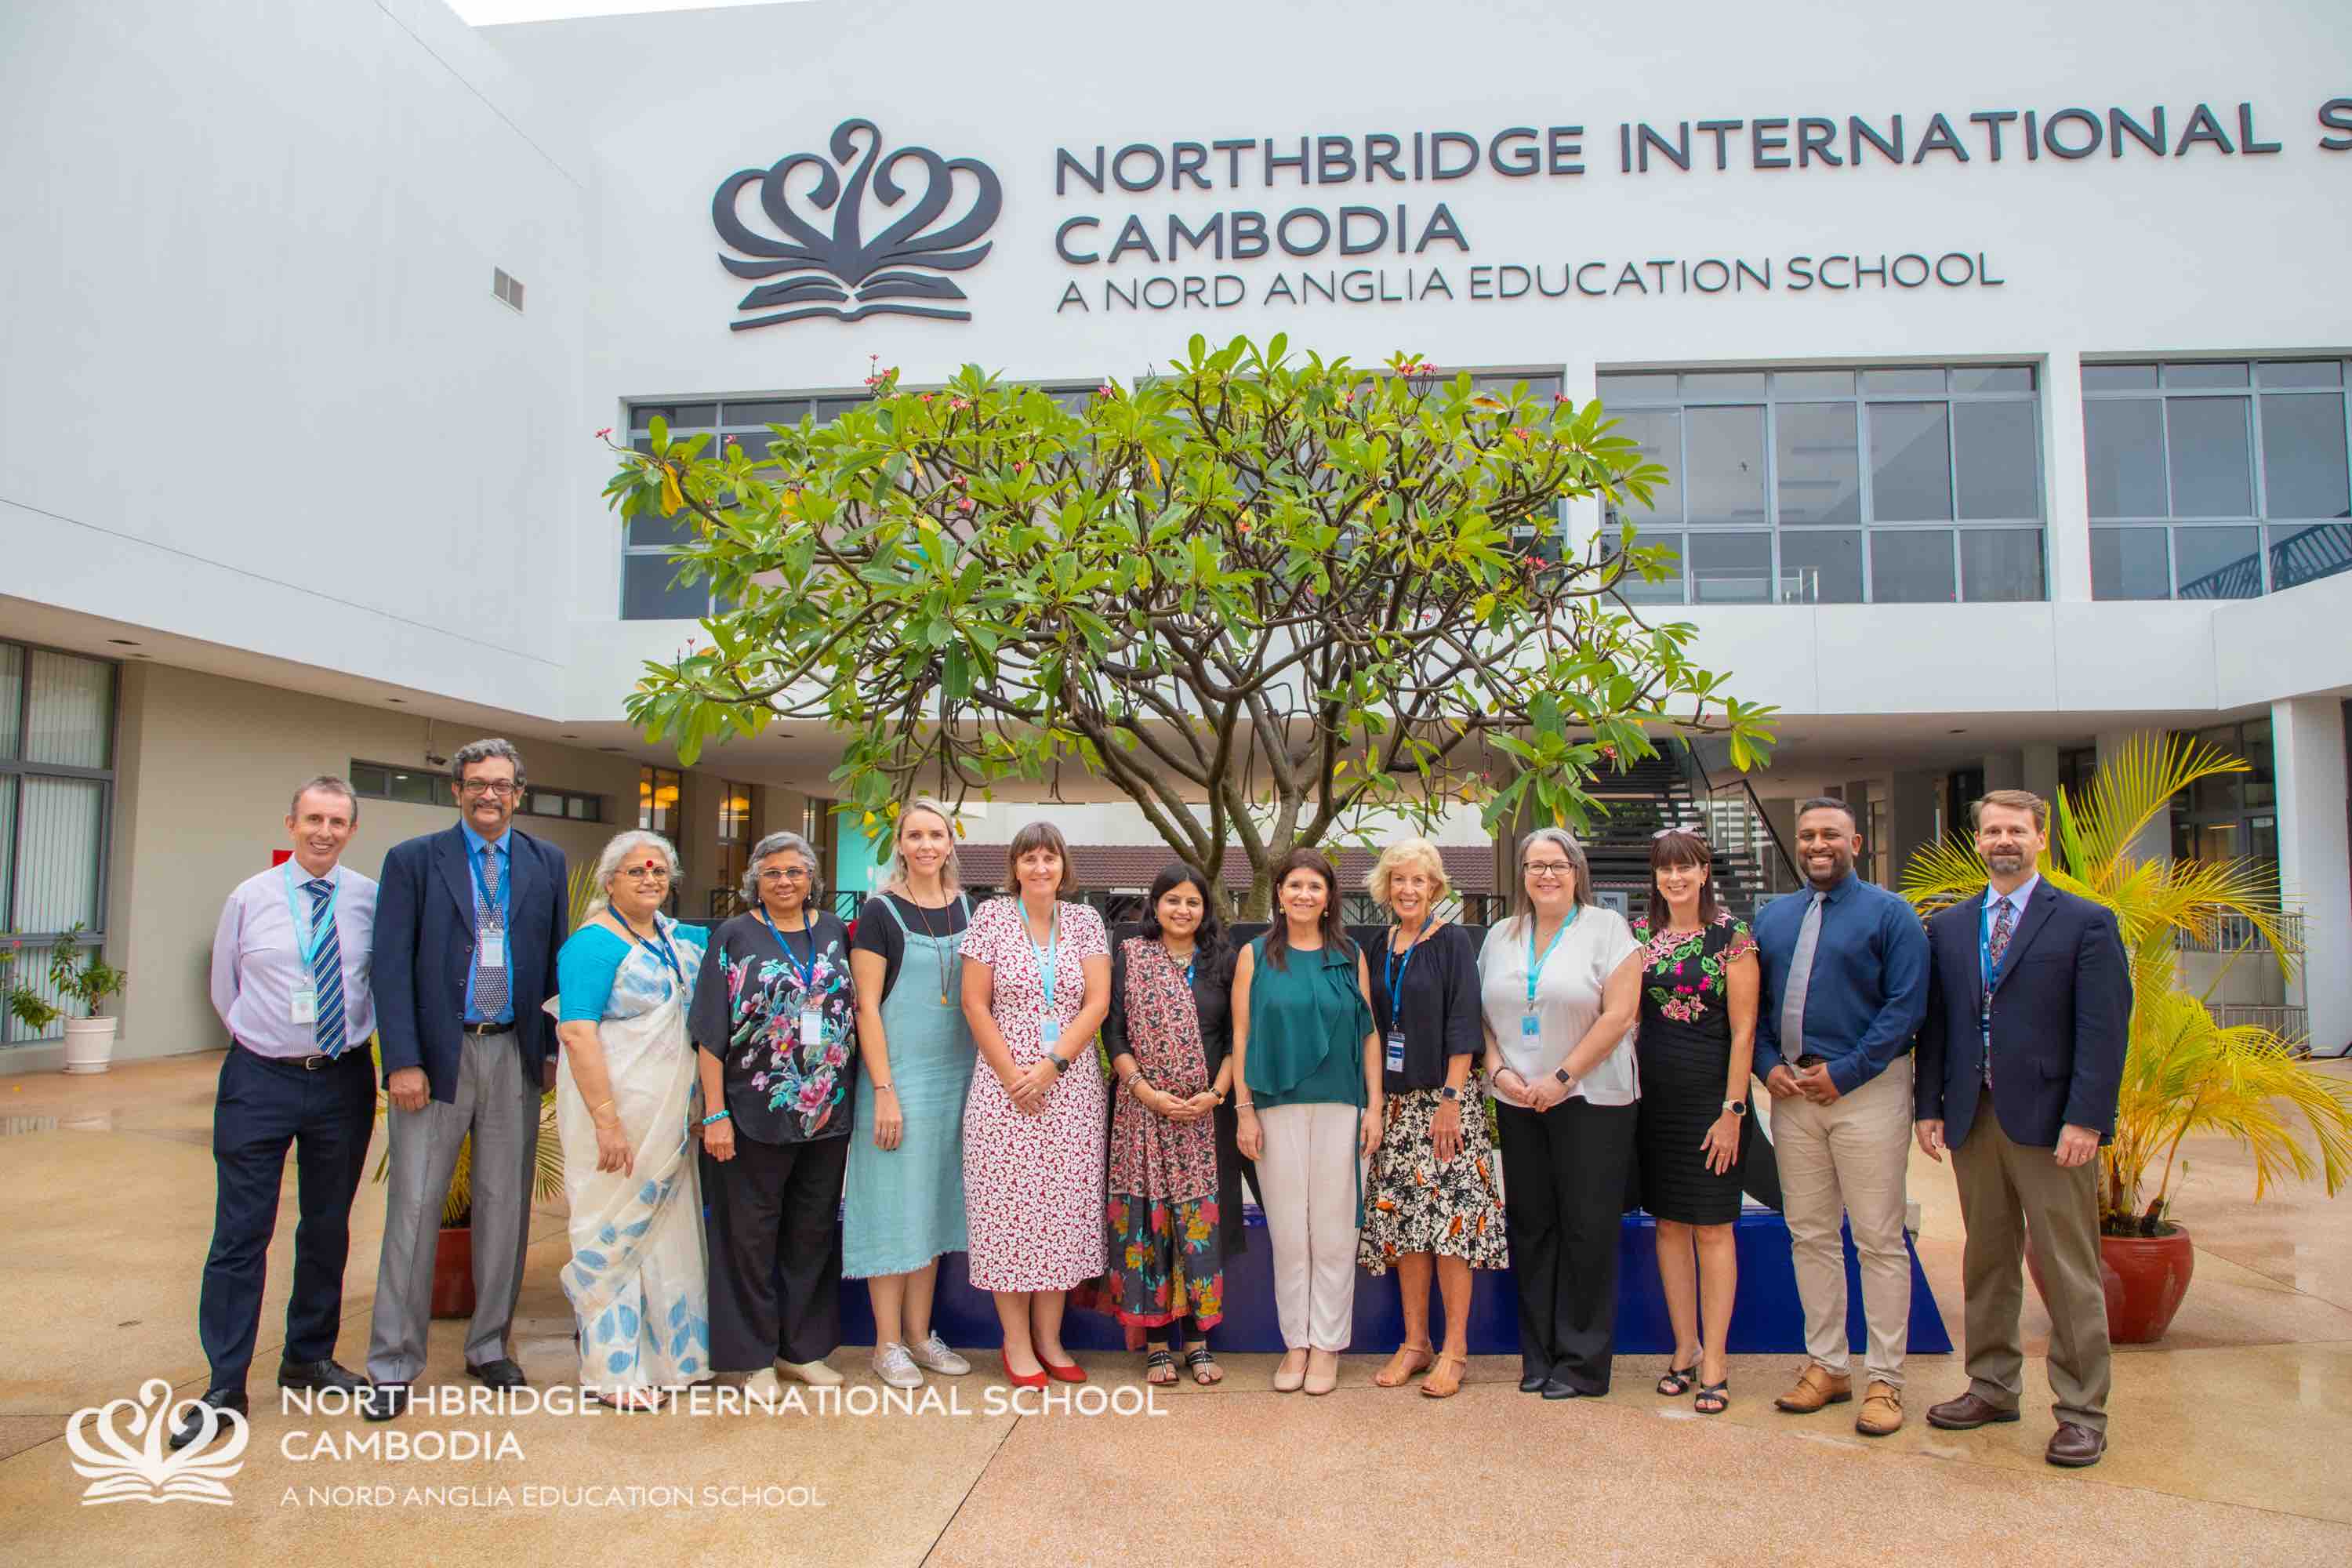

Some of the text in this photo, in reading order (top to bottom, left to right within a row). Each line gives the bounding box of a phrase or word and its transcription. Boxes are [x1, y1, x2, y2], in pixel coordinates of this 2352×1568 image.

[1056, 125, 1585, 196] NORTHBRIDGE
[1621, 102, 2282, 176] INTERNATIONAL
[1055, 203, 1470, 266] CAMBODIA
[1057, 252, 2005, 314] A NORD ANGLIA EDUCATION SCHOOL
